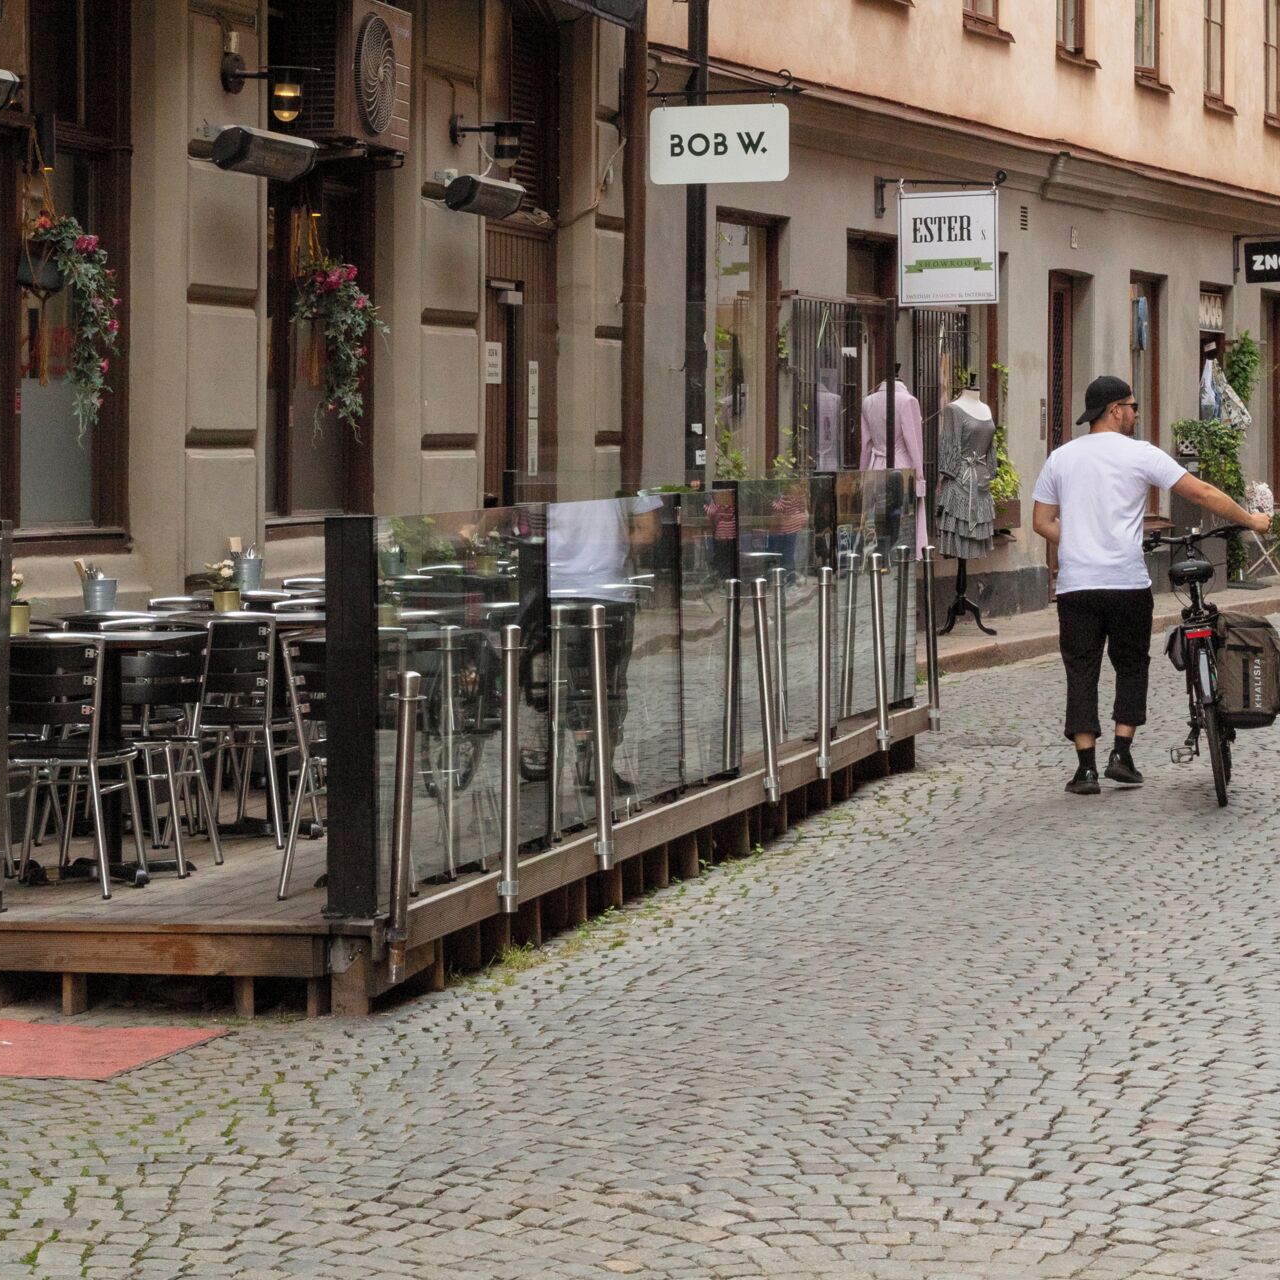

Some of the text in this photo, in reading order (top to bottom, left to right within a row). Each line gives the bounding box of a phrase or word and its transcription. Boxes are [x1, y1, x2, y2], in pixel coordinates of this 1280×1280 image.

[670, 131, 768, 157] BOB W.
[912, 215, 972, 243] ESTER
[919, 258, 981, 269] SHOWROOM
[1254, 659, 1262, 708] KHALISIA
